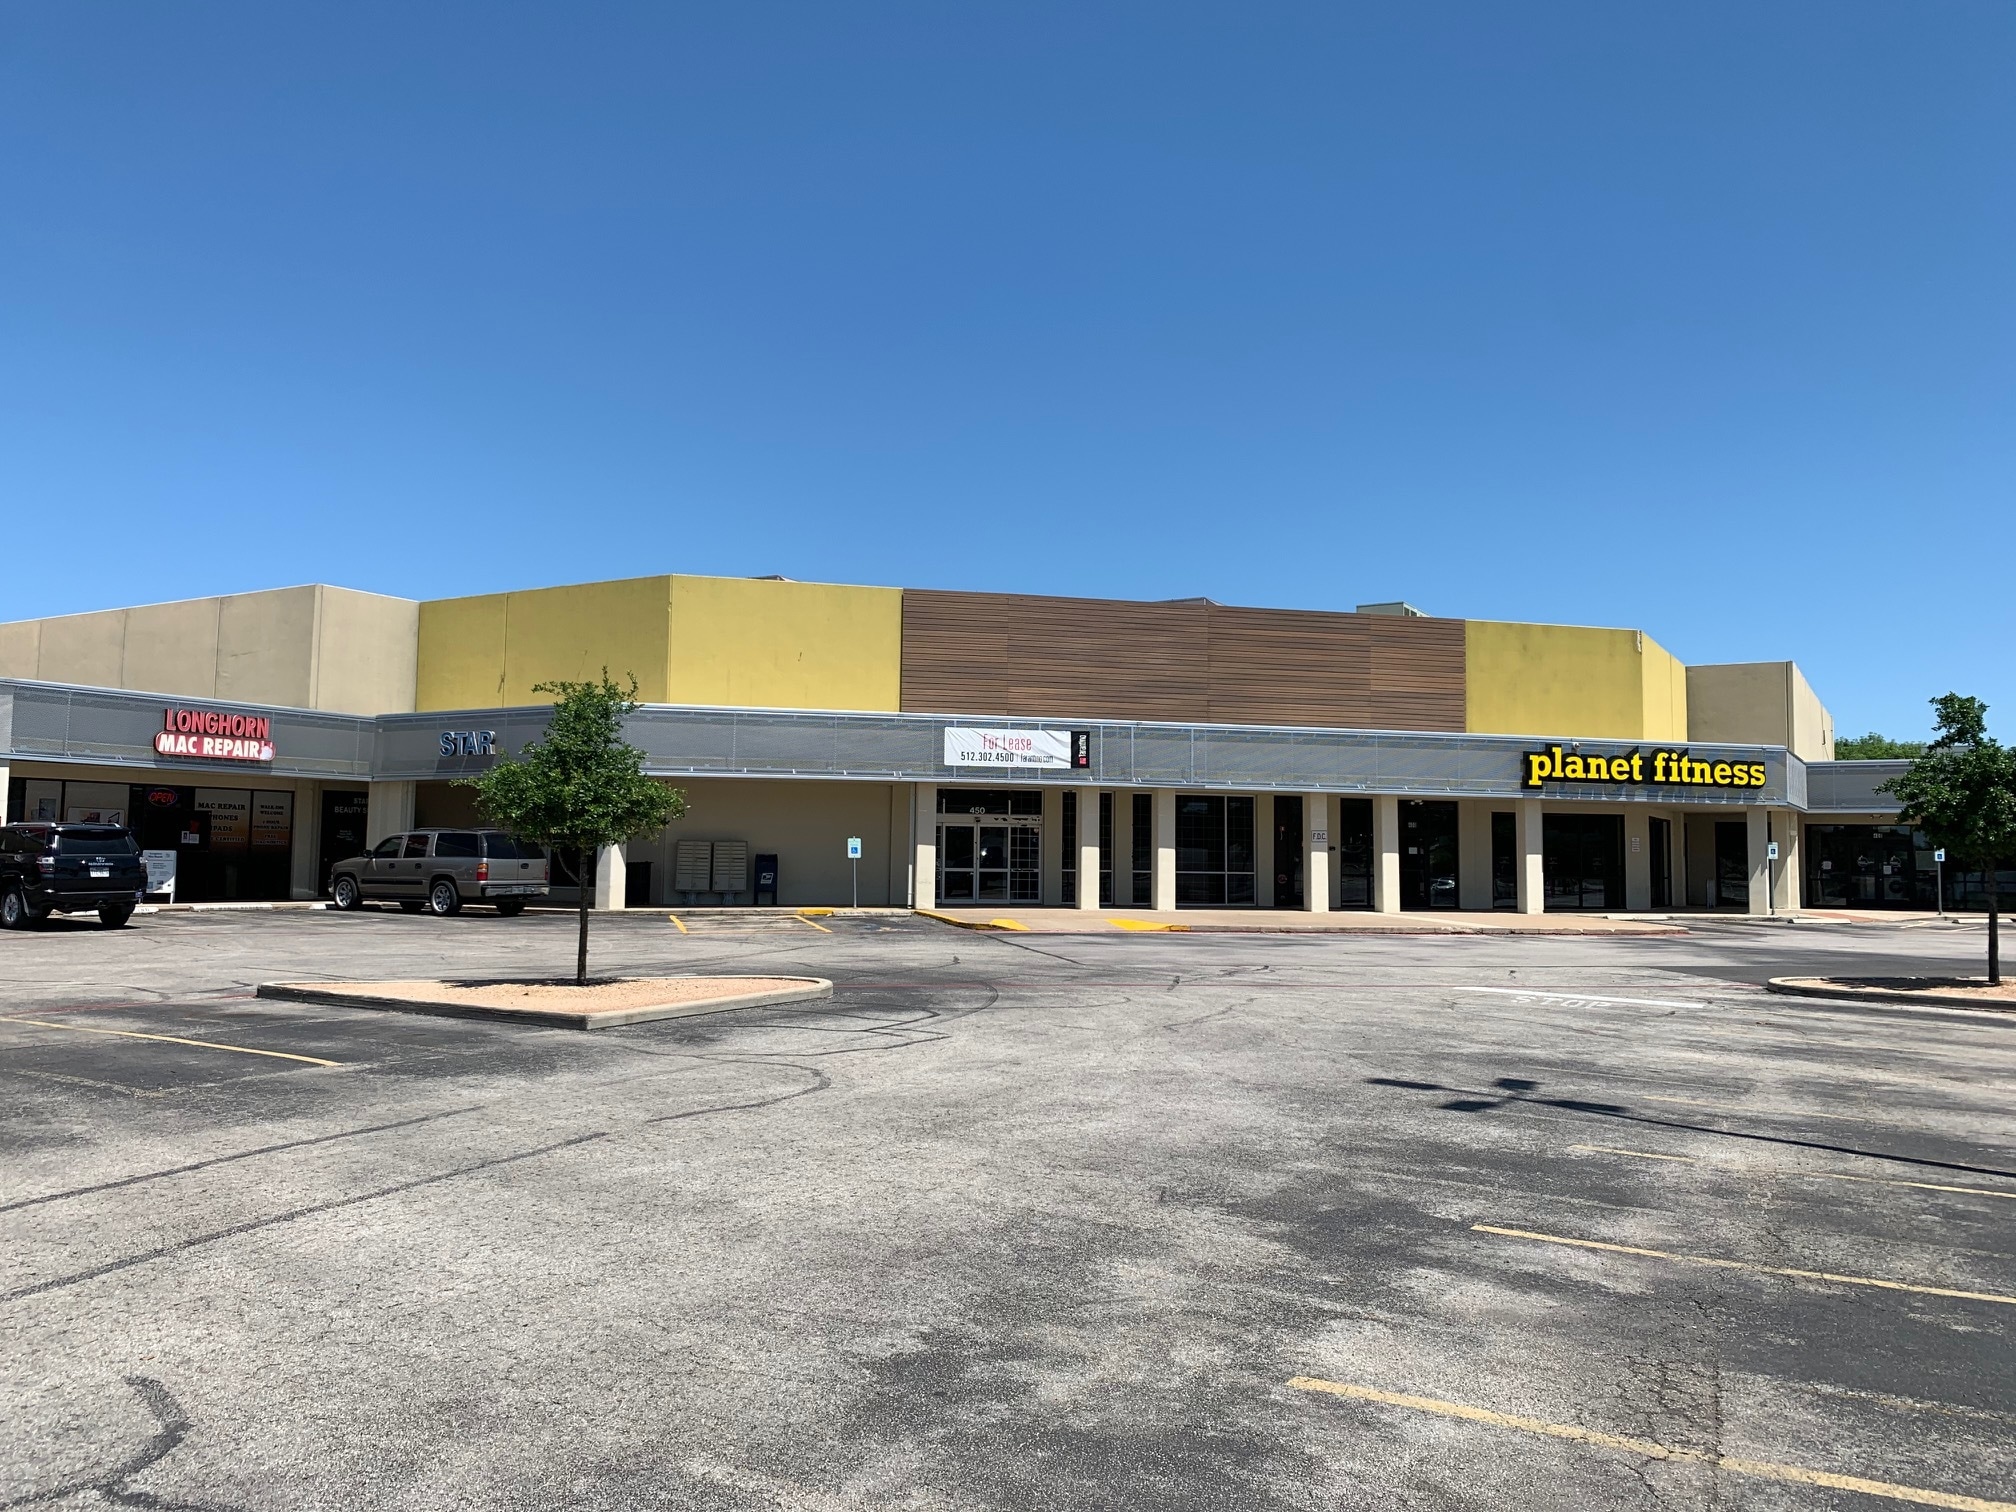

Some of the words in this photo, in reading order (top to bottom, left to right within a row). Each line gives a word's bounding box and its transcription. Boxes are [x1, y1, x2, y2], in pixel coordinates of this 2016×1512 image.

[166, 708, 270, 738] LONGHORN
[159, 733, 198, 754] MAC
[203, 737, 260, 759] REPAIR
[439, 729, 496, 757] STAR
[983, 733, 999, 750] For
[1003, 734, 1032, 751] Lease
[960, 751, 1014, 763] 512.302.4500
[1528, 746, 1643, 786] planet
[1654, 751, 1767, 786] fitness
[149, 792, 175, 803] OPEN
[198, 802, 216, 810] MAC
[218, 803, 246, 811] REPAIR
[334, 805, 361, 814] BEAUTY
[969, 806, 986, 815] 450
[1511, 995, 1613, 1009] STOP
